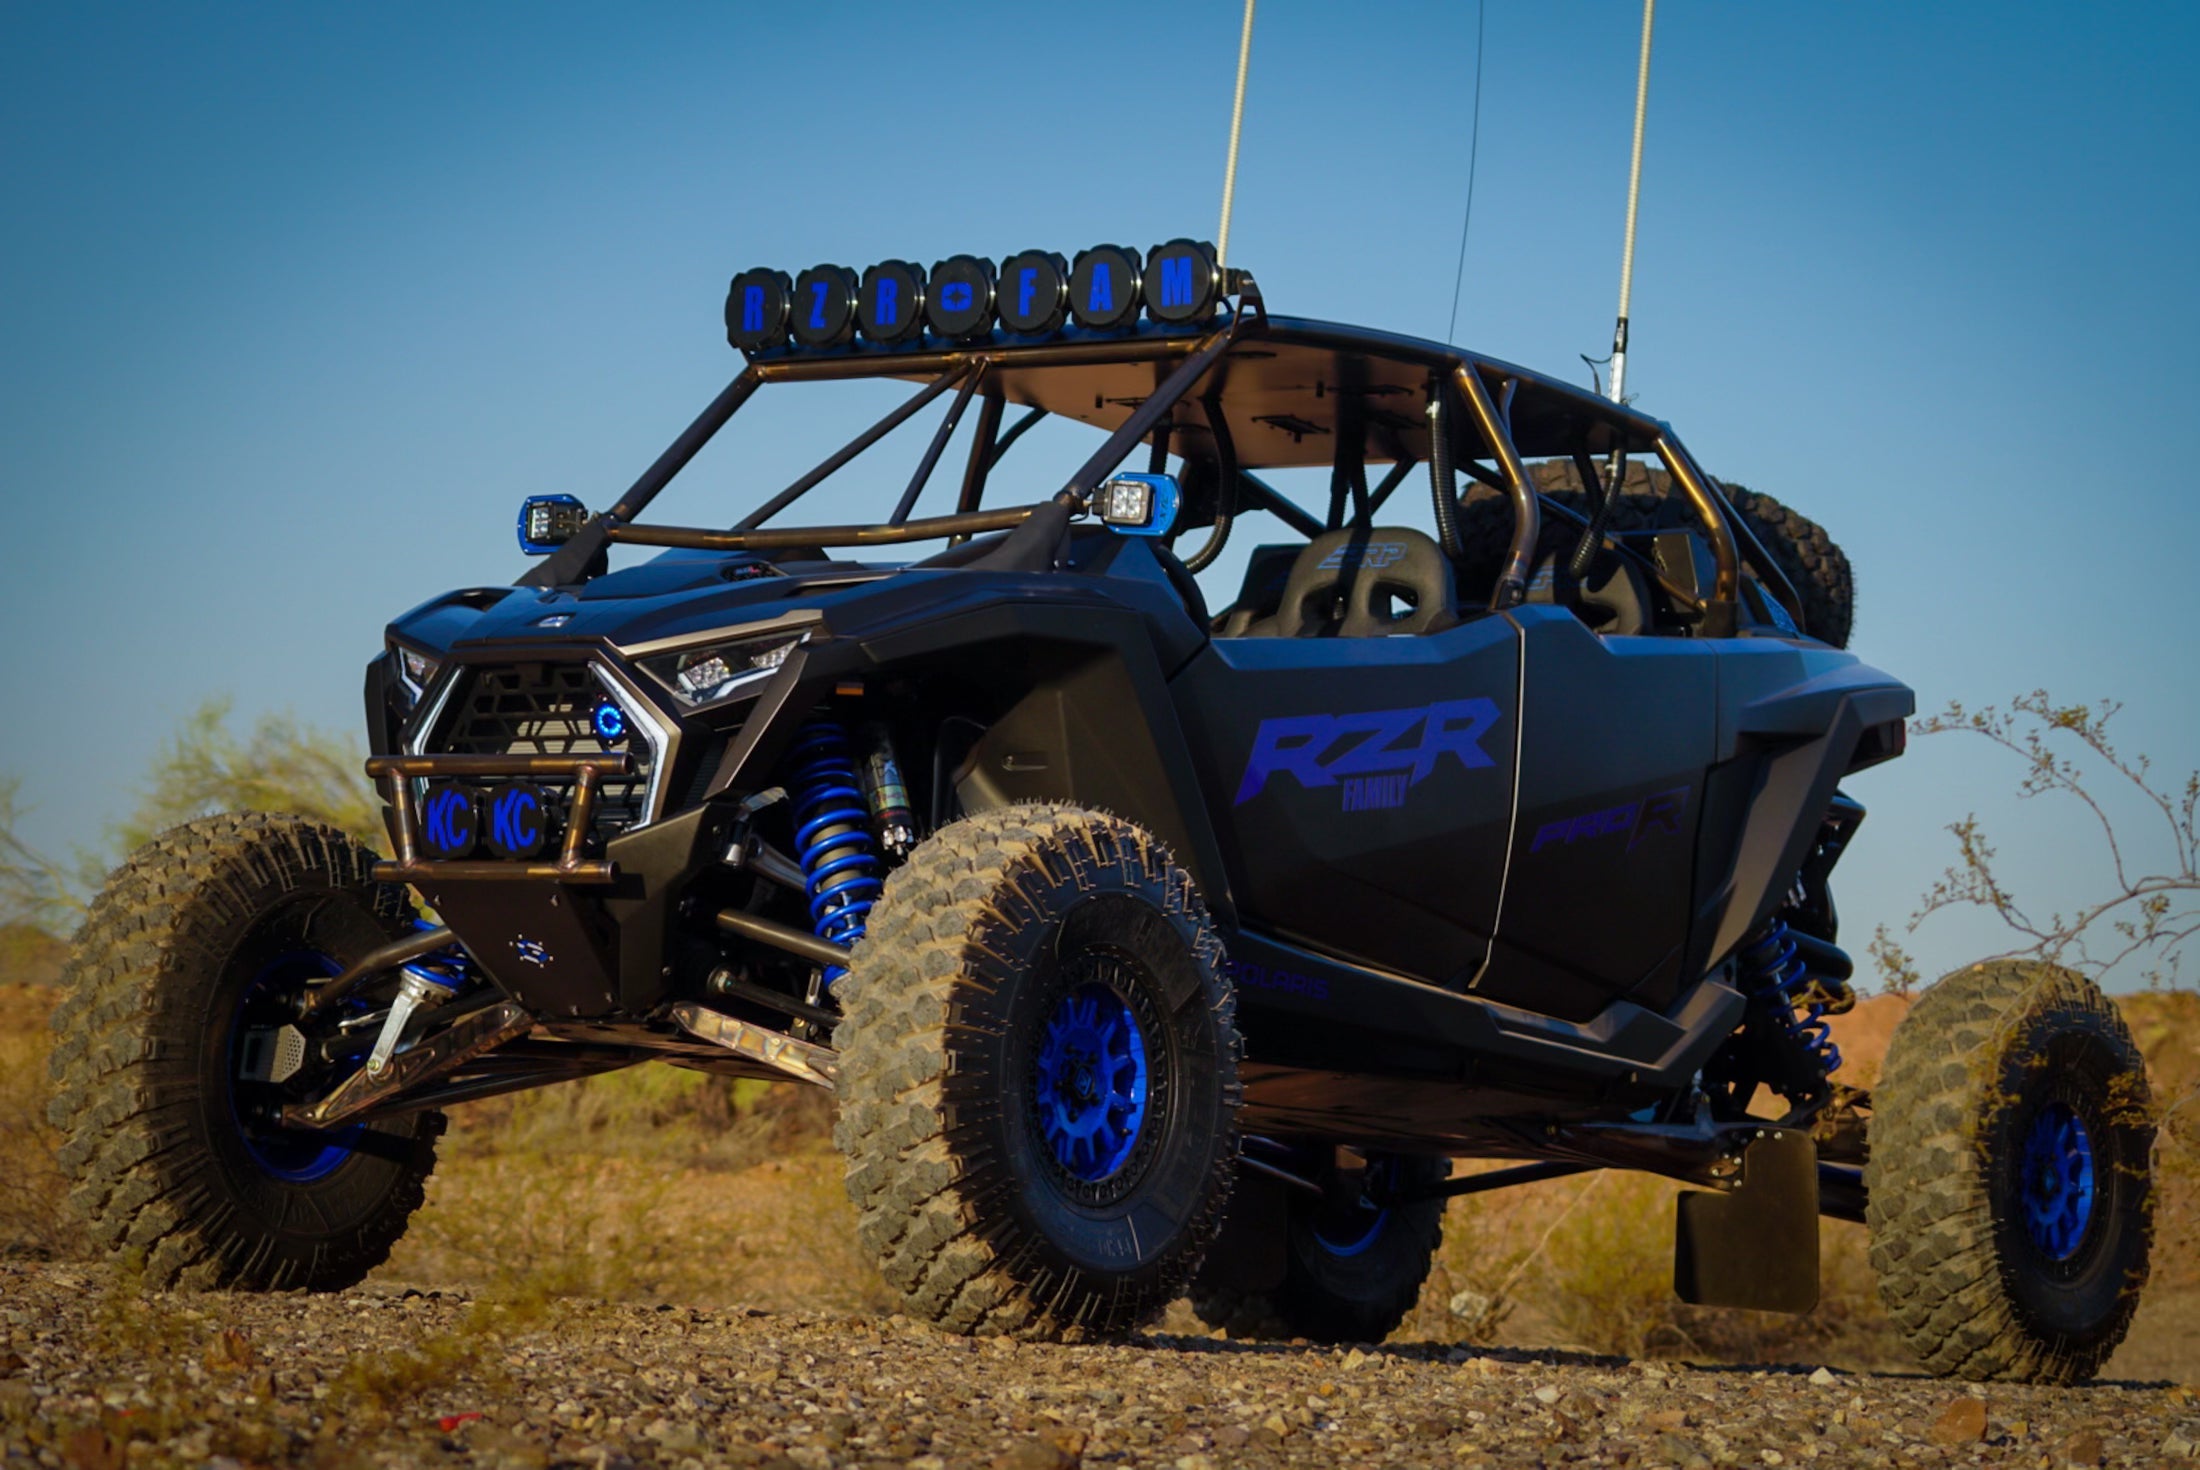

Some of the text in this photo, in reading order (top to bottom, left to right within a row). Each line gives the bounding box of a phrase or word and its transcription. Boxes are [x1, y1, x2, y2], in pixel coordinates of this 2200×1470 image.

[742, 256, 1193, 332] RZR FAM
[1234, 696, 1502, 807] RZR
[427, 788, 468, 852] KC
[493, 788, 537, 852] KC
[1341, 773, 1411, 812] FAMILY
[1223, 959, 1330, 1001] POLARIS
